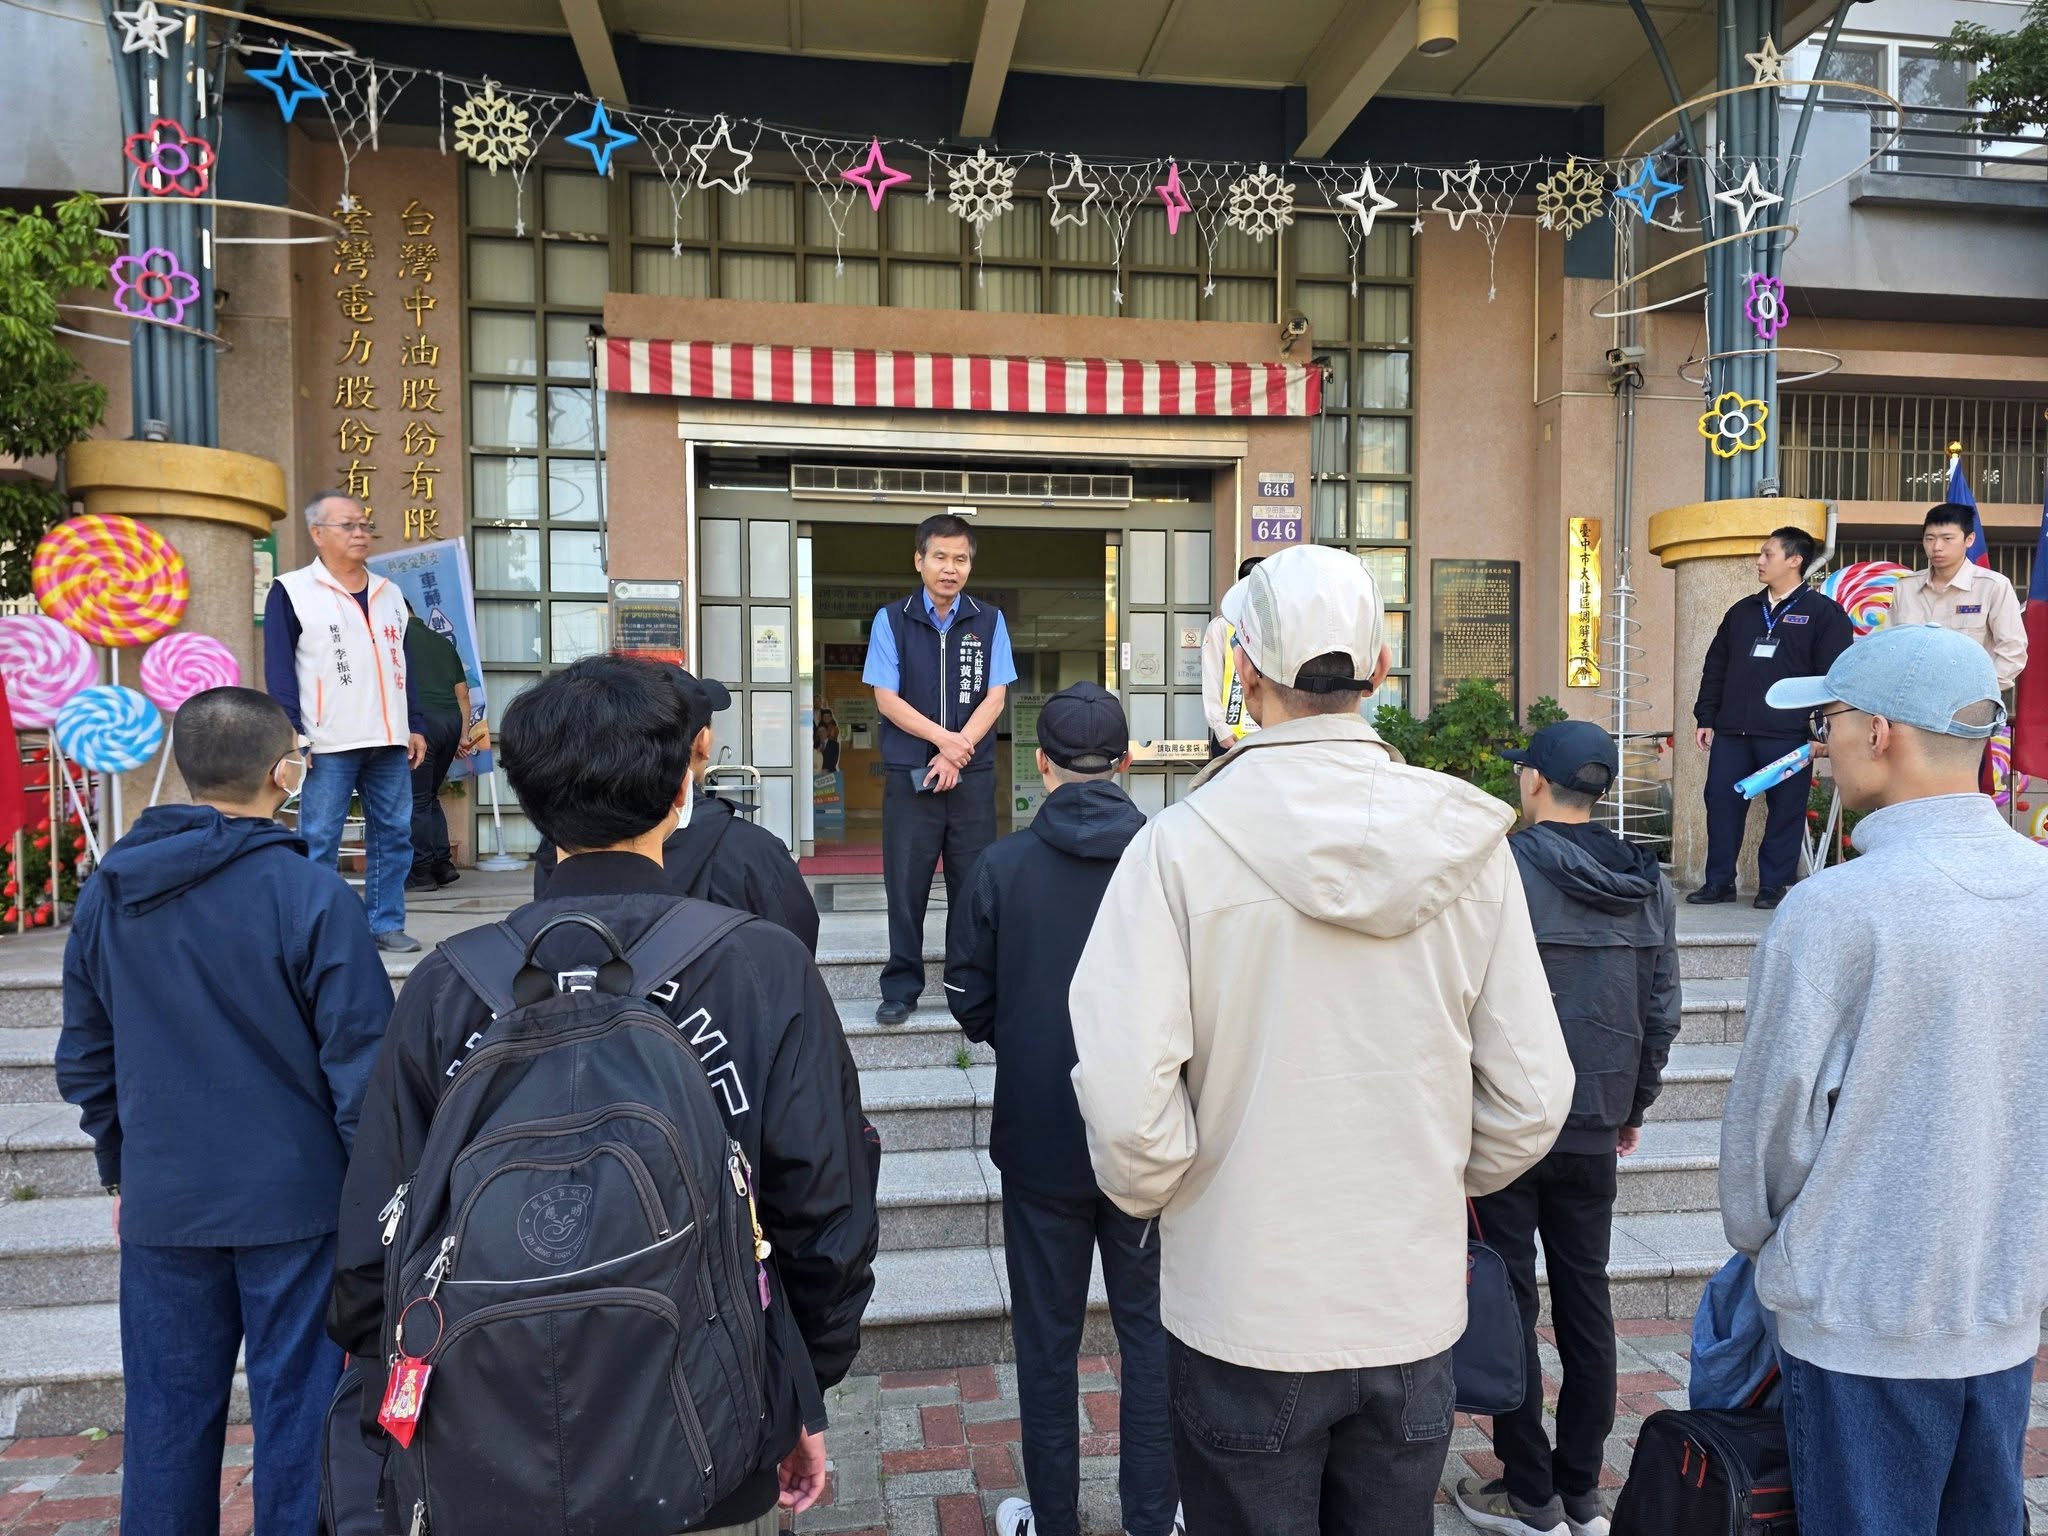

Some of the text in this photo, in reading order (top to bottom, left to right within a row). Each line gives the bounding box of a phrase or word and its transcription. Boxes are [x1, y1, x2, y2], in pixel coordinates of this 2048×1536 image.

[332, 196, 384, 539] 臺灣電力股份有
[398, 200, 445, 542] 台灣中油股份有限
[1264, 483, 1289, 496] 646
[1257, 520, 1297, 540] 646
[959, 665, 971, 704] 黃金龍
[974, 650, 983, 692] 大肚區公所
